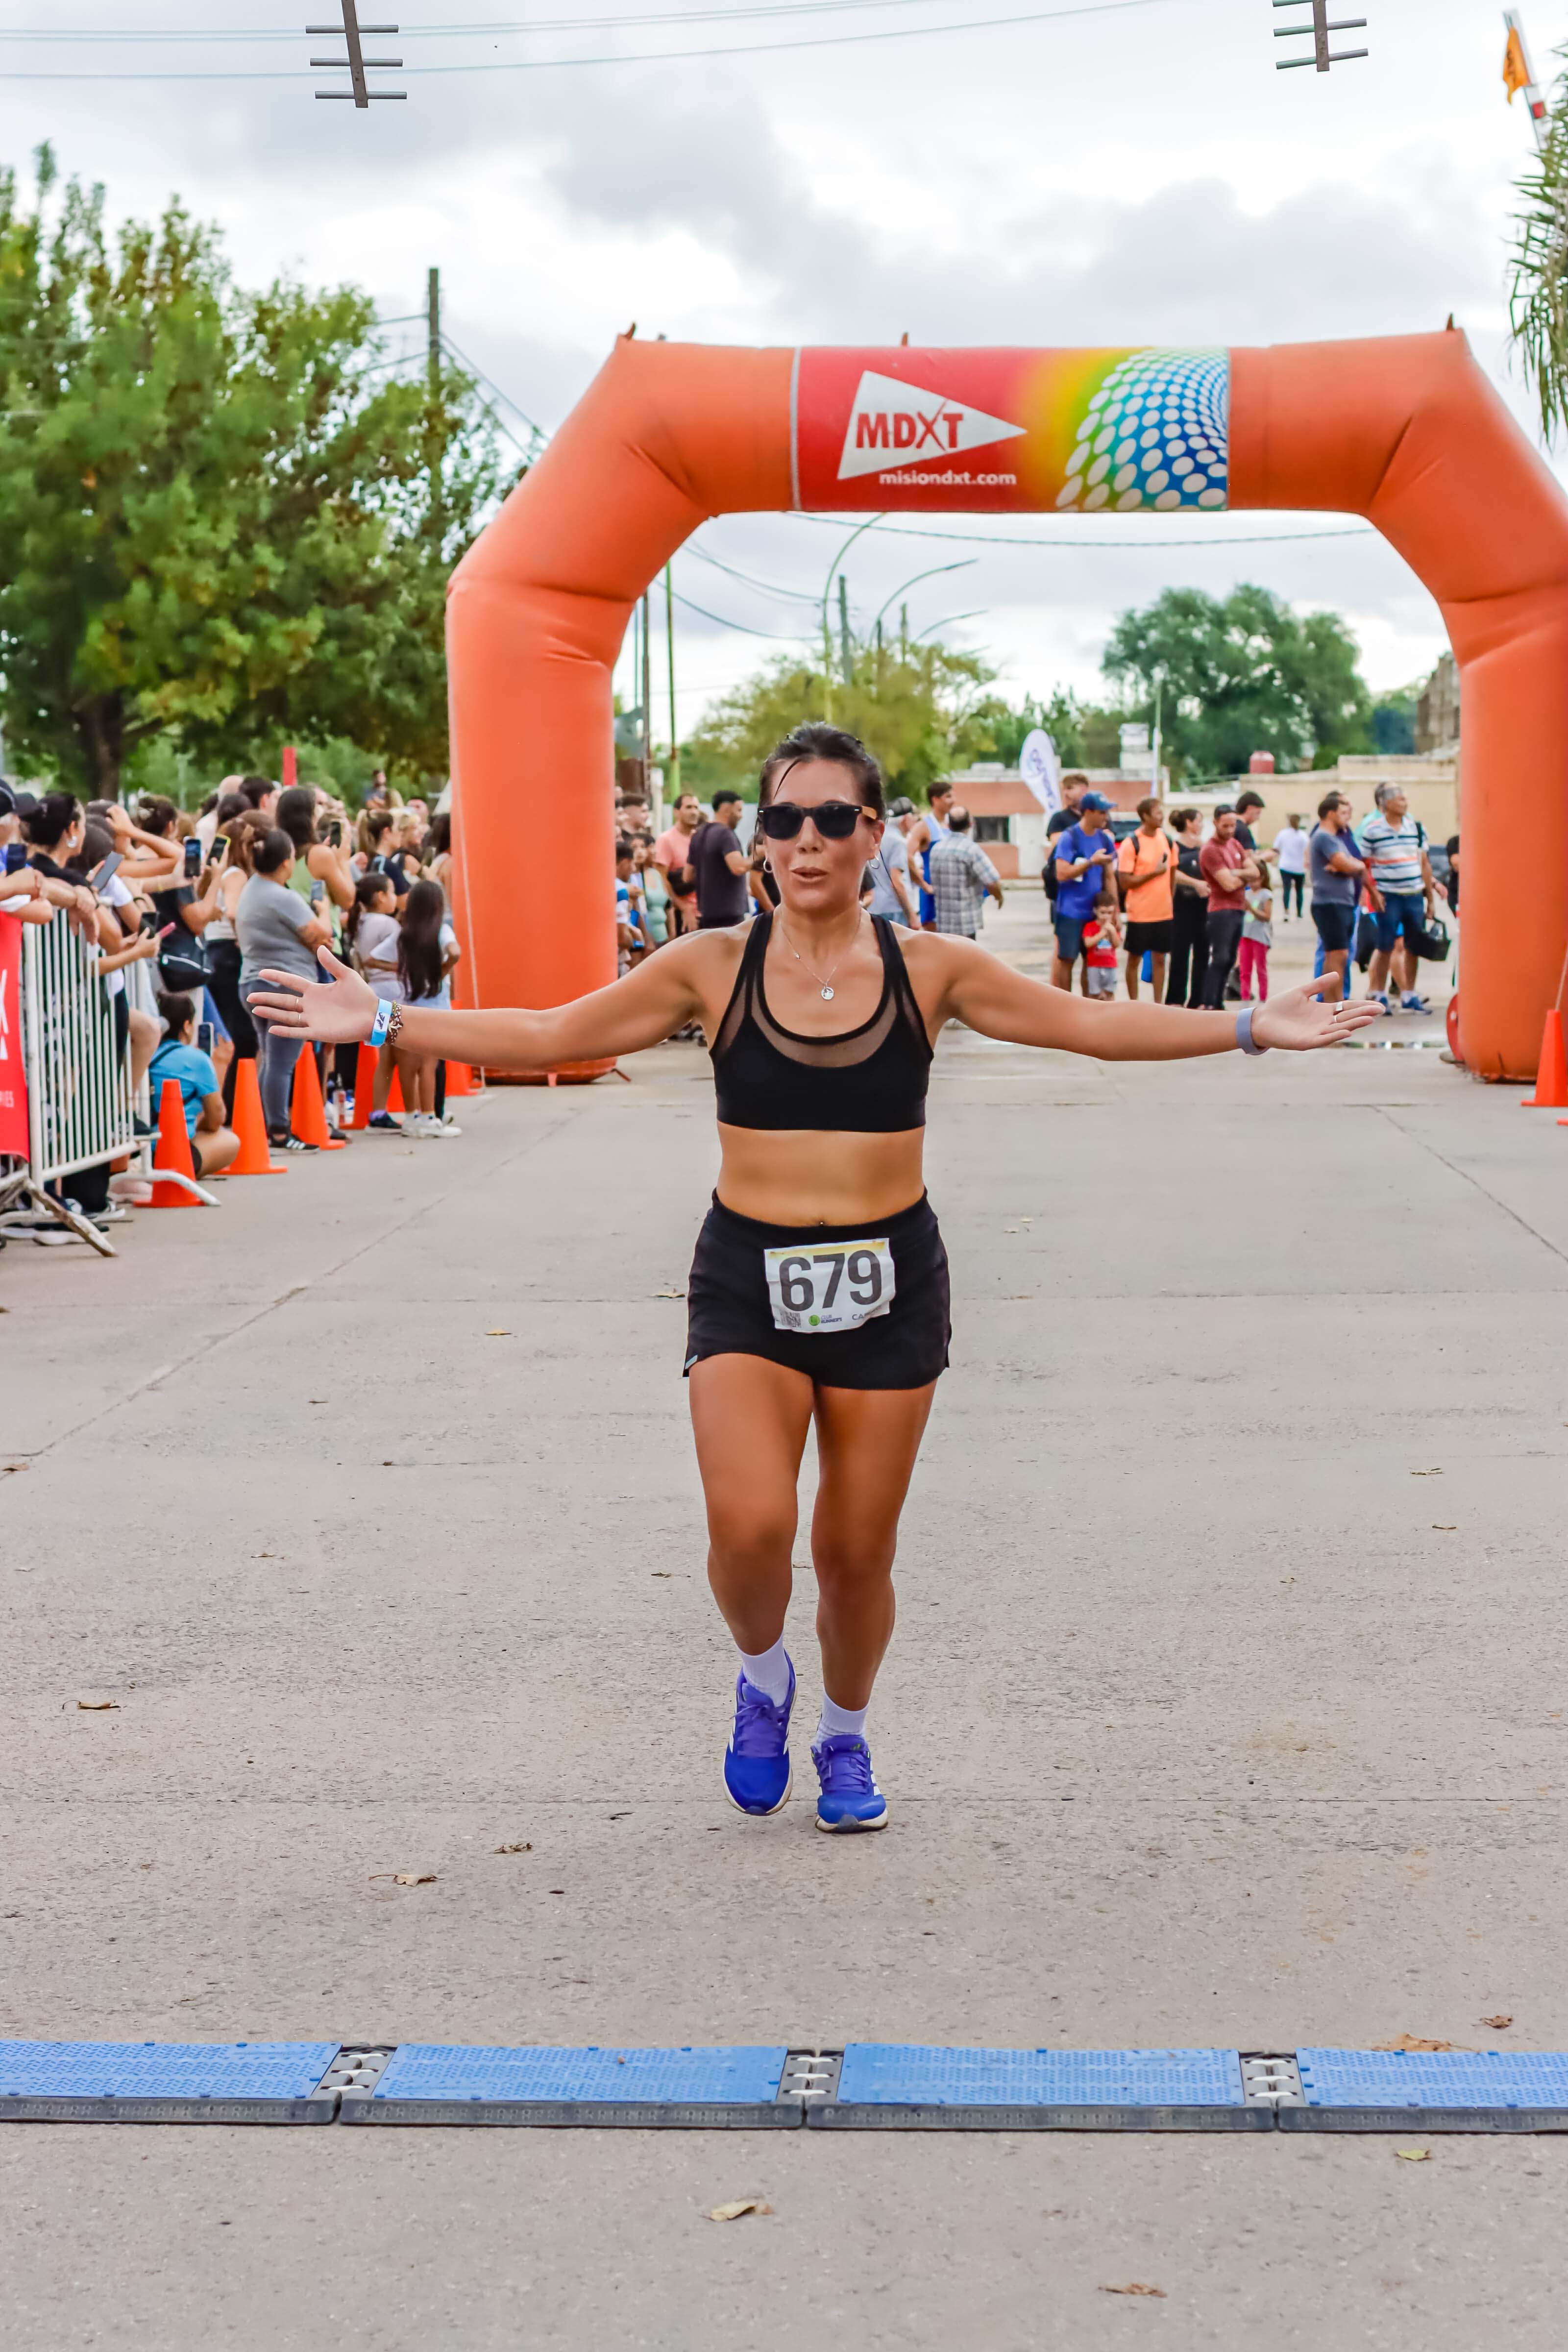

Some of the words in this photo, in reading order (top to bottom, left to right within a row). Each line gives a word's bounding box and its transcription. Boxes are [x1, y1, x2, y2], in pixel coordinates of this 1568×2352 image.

[856, 401, 963, 452] MDXT
[879, 470, 1017, 486] misiondxt.com
[779, 1250, 882, 1311] 679
